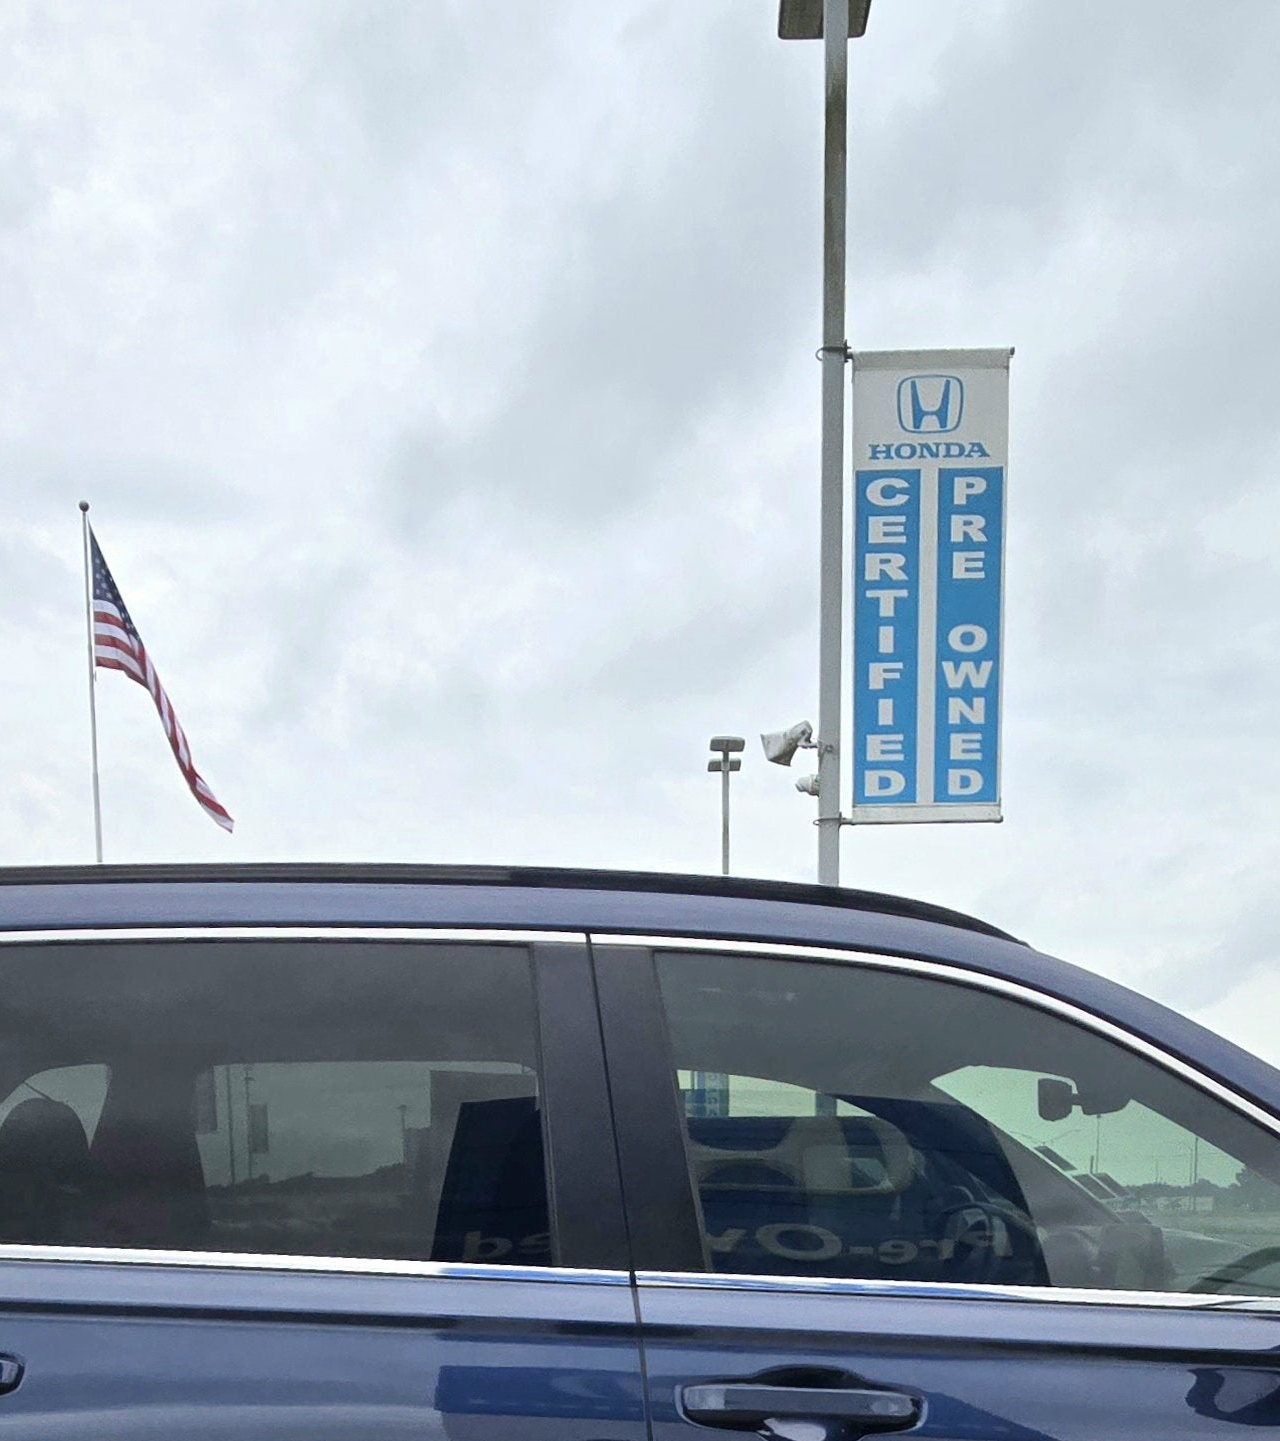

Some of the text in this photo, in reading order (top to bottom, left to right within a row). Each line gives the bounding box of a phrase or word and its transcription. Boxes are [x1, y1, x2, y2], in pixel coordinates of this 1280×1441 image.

[868, 442, 990, 460] HONDA
[864, 477, 910, 797] CERTIFIED
[942, 476, 993, 796] PRE OWNED
